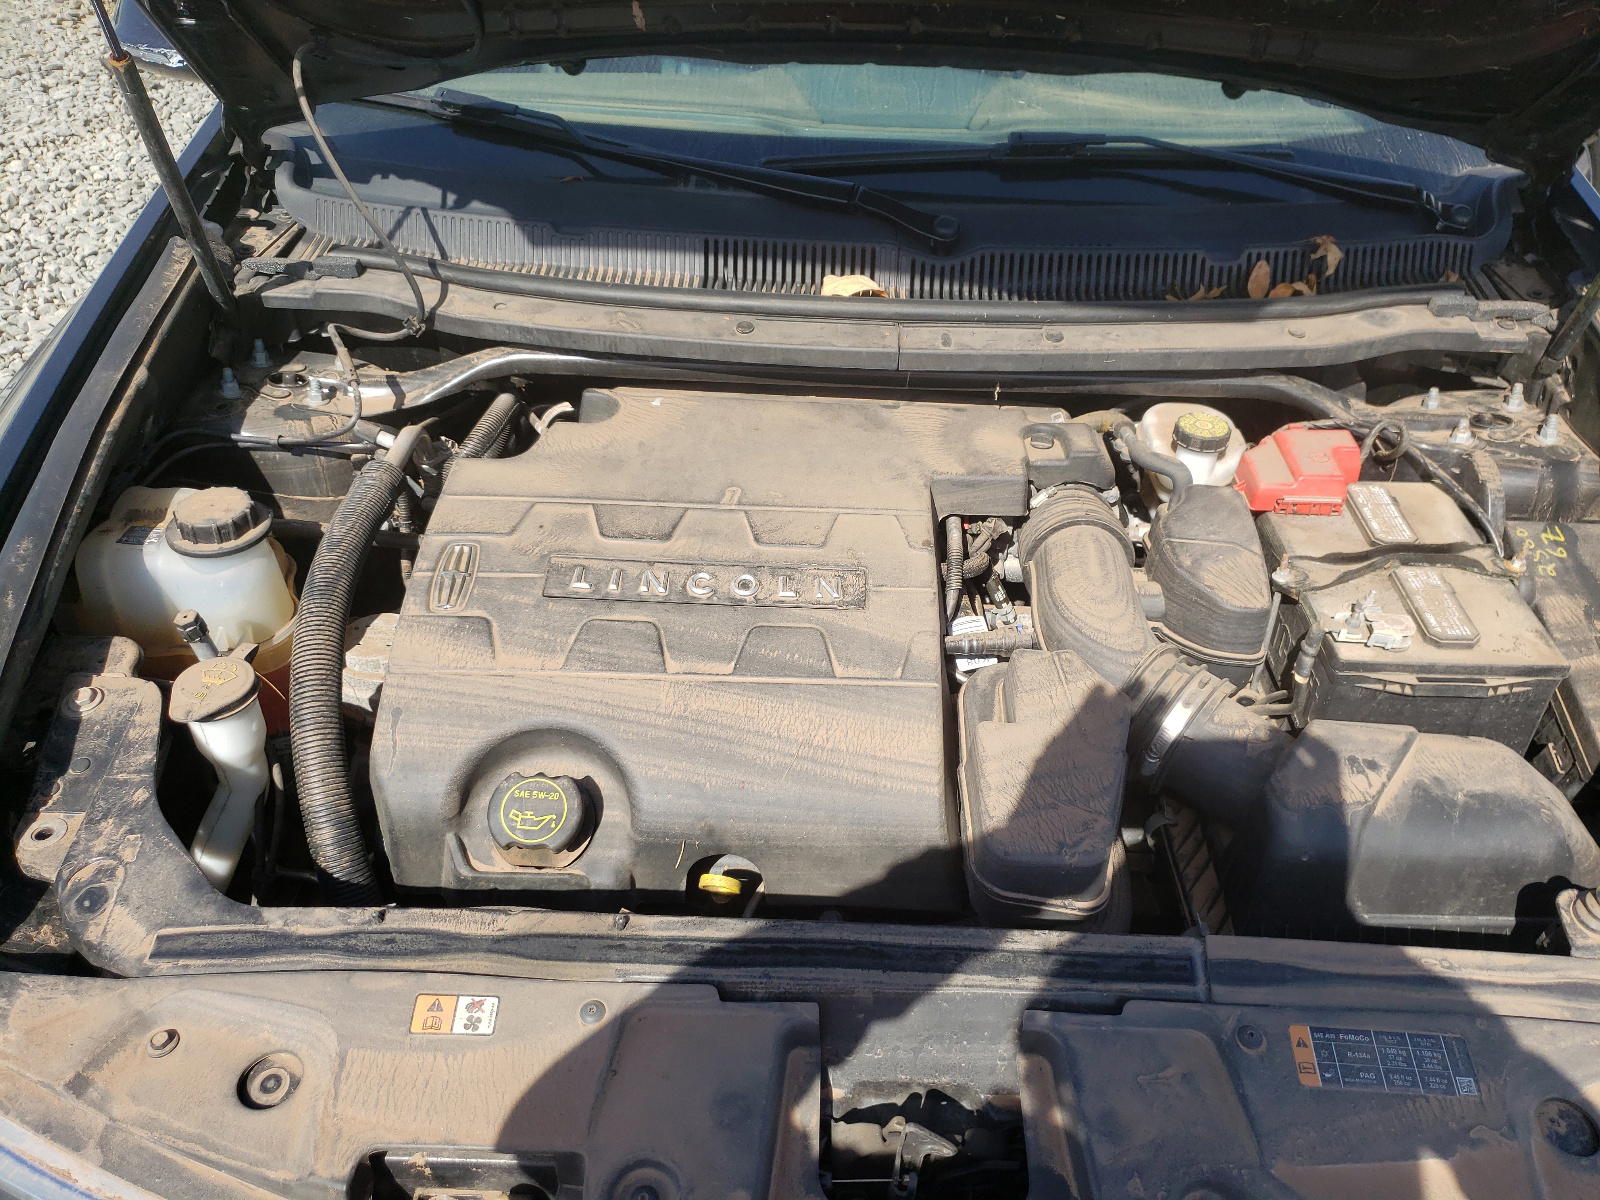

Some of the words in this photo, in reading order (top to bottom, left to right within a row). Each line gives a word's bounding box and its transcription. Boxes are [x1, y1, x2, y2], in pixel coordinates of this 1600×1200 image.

[570, 566, 842, 599] LINCOLN
[514, 789, 531, 799] SAE
[532, 791, 560, 801] 5W-20
[1340, 1033, 1370, 1042] FoMoCo
[1347, 1051, 1371, 1059] R-134a
[1360, 1072, 1376, 1080] PAG
